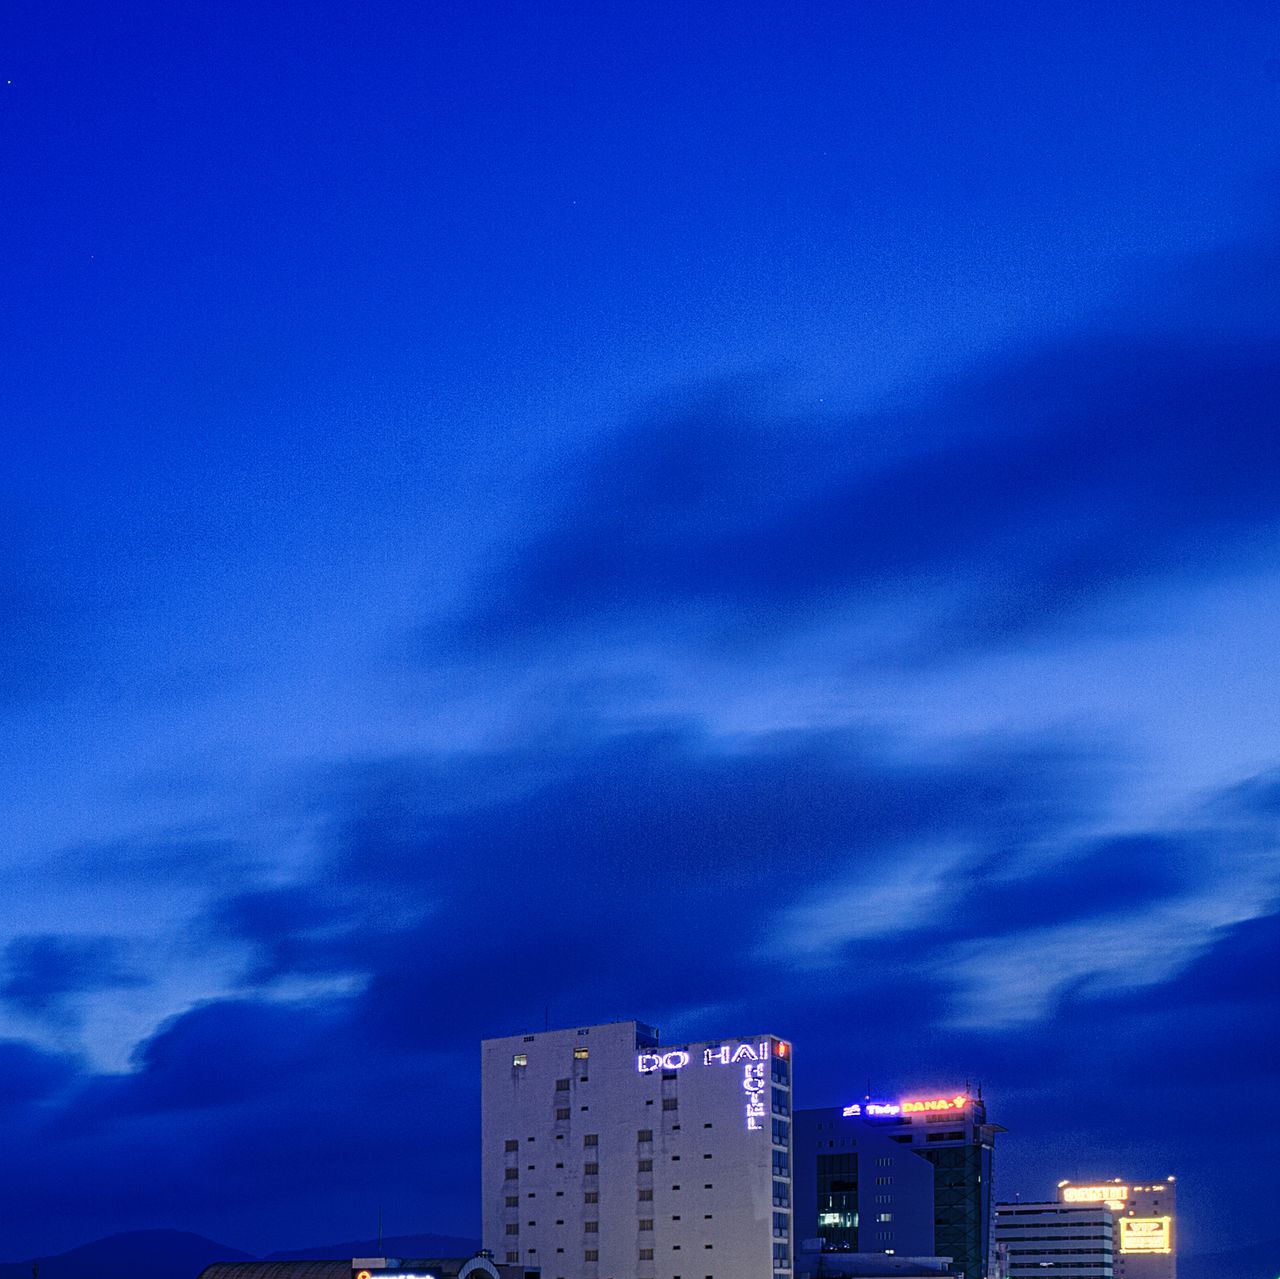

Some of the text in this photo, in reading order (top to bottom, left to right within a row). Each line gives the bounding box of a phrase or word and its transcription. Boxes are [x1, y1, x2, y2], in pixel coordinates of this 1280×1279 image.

[638, 1041, 769, 1073] DO HAI
[743, 1062, 766, 1131] HOTEL
